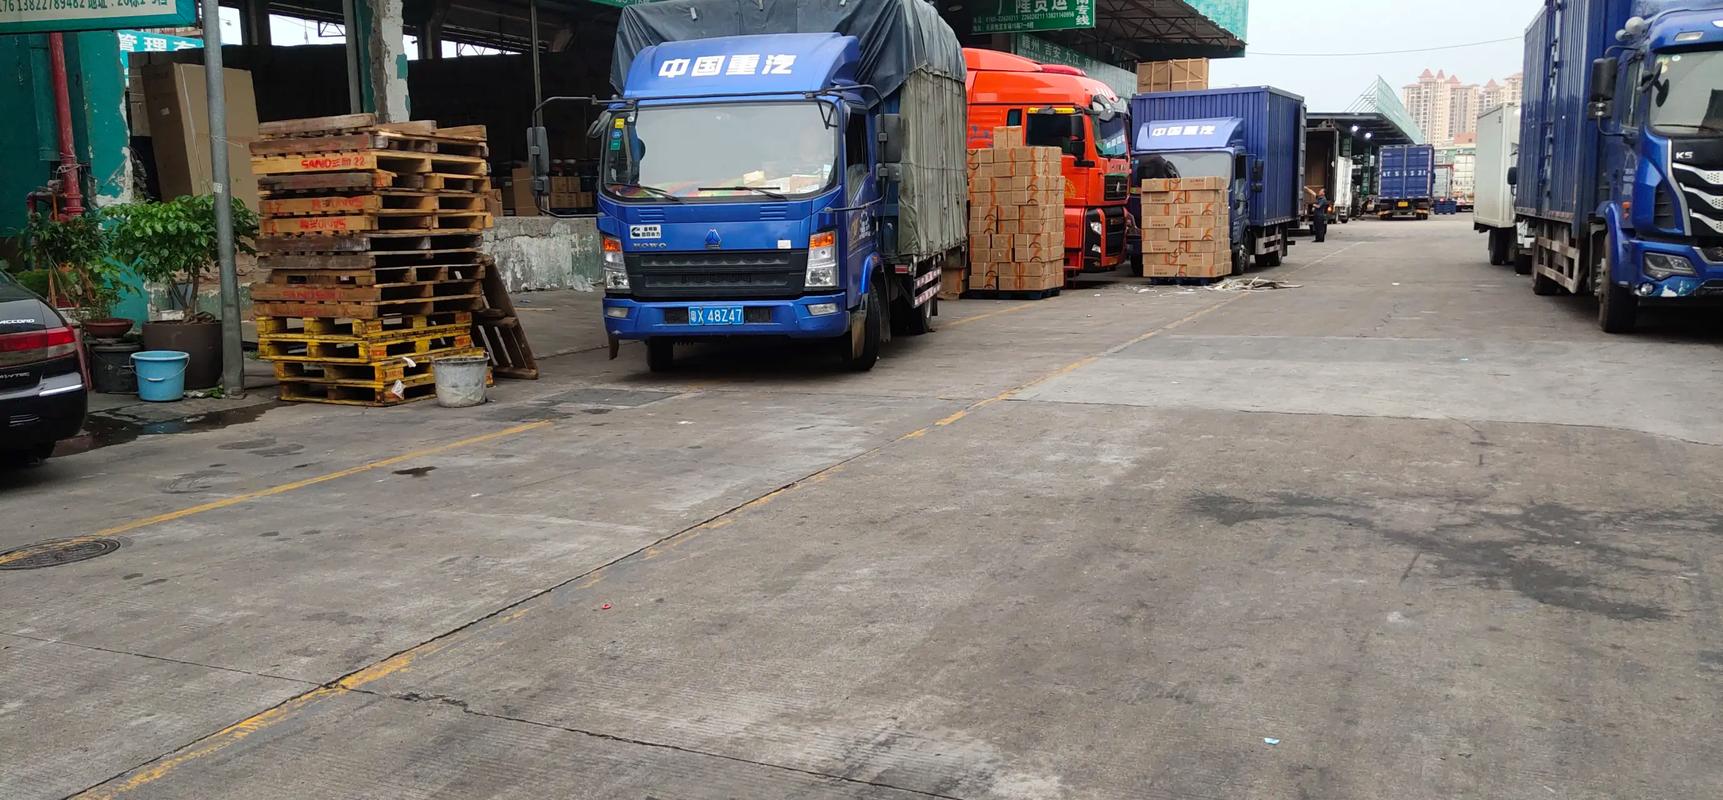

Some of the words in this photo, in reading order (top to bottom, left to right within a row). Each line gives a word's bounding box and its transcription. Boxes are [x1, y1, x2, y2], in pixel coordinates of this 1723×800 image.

[1044, 43, 1061, 59] 吉安
[658, 54, 797, 78] 中国重汽
[1152, 125, 1216, 136] 中国重汽
[707, 308, 742, 322] 48Z47
